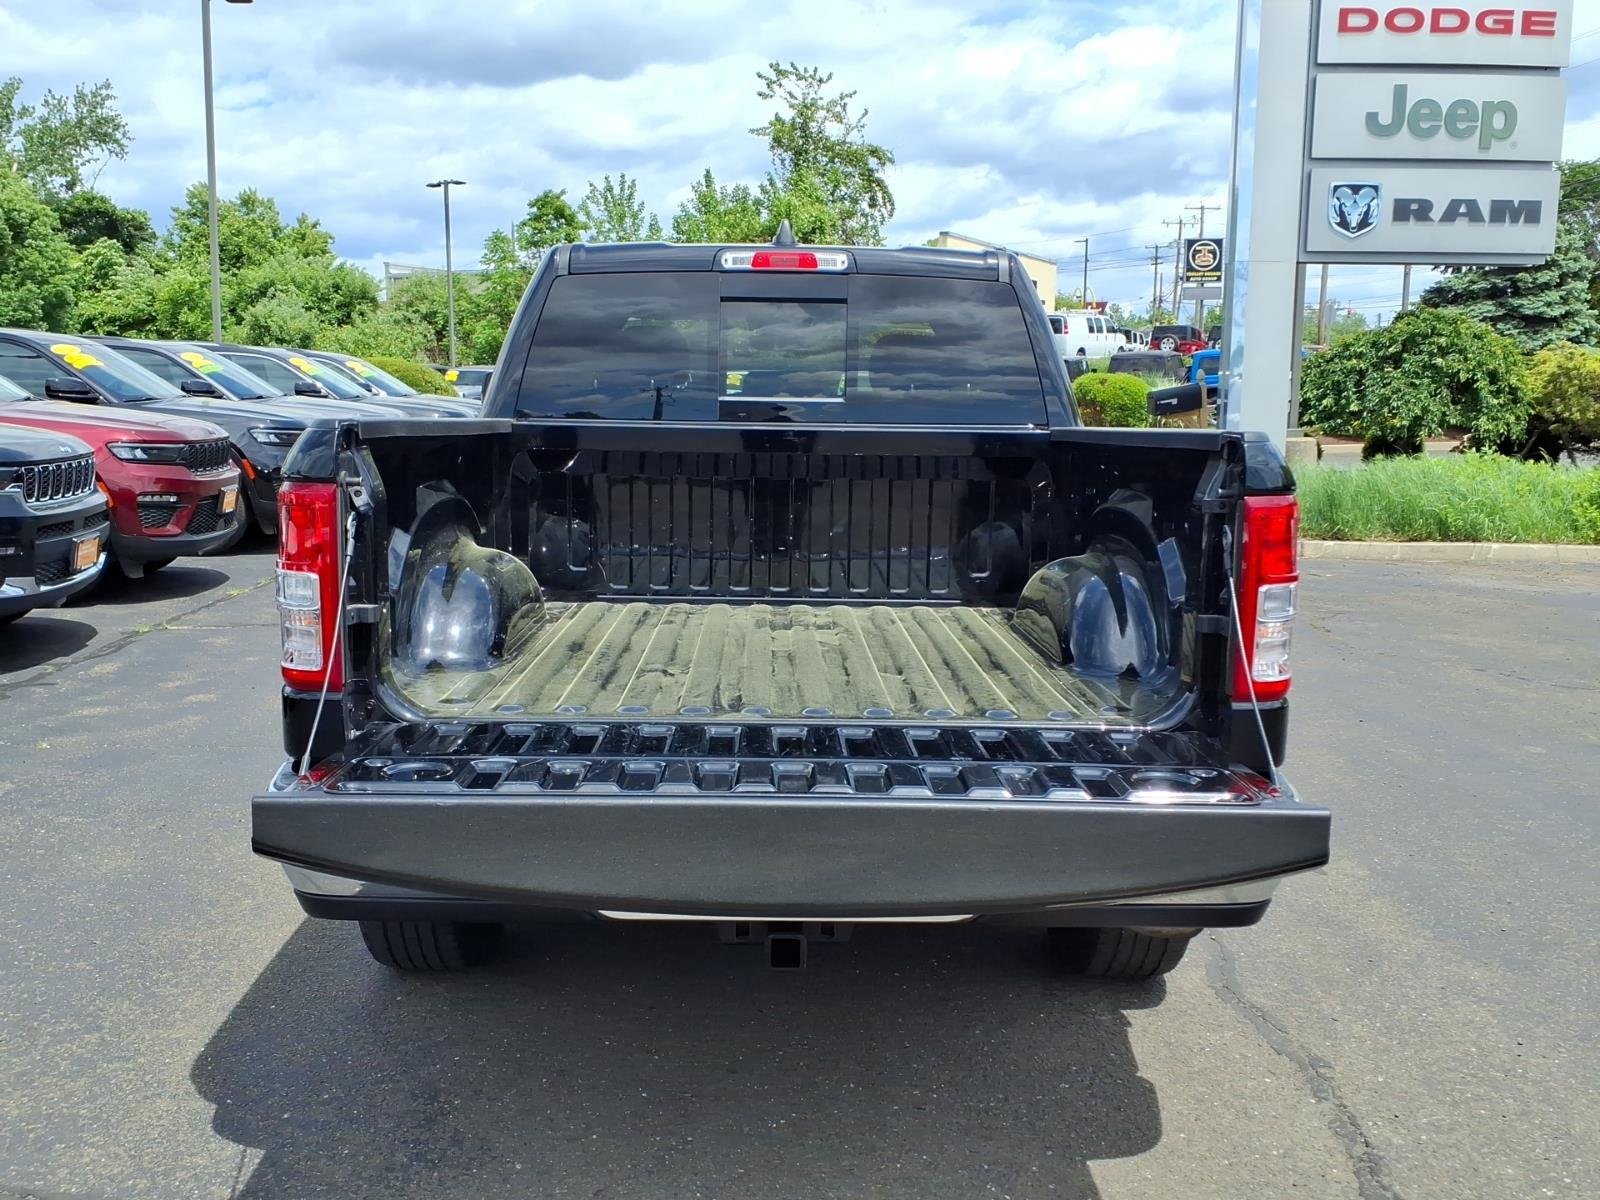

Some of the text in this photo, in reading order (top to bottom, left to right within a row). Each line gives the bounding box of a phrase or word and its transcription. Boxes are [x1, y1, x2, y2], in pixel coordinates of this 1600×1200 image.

[1338, 7, 1558, 37] DODGE
[1365, 84, 1518, 150] Jeep
[1392, 198, 1543, 224] RAM
